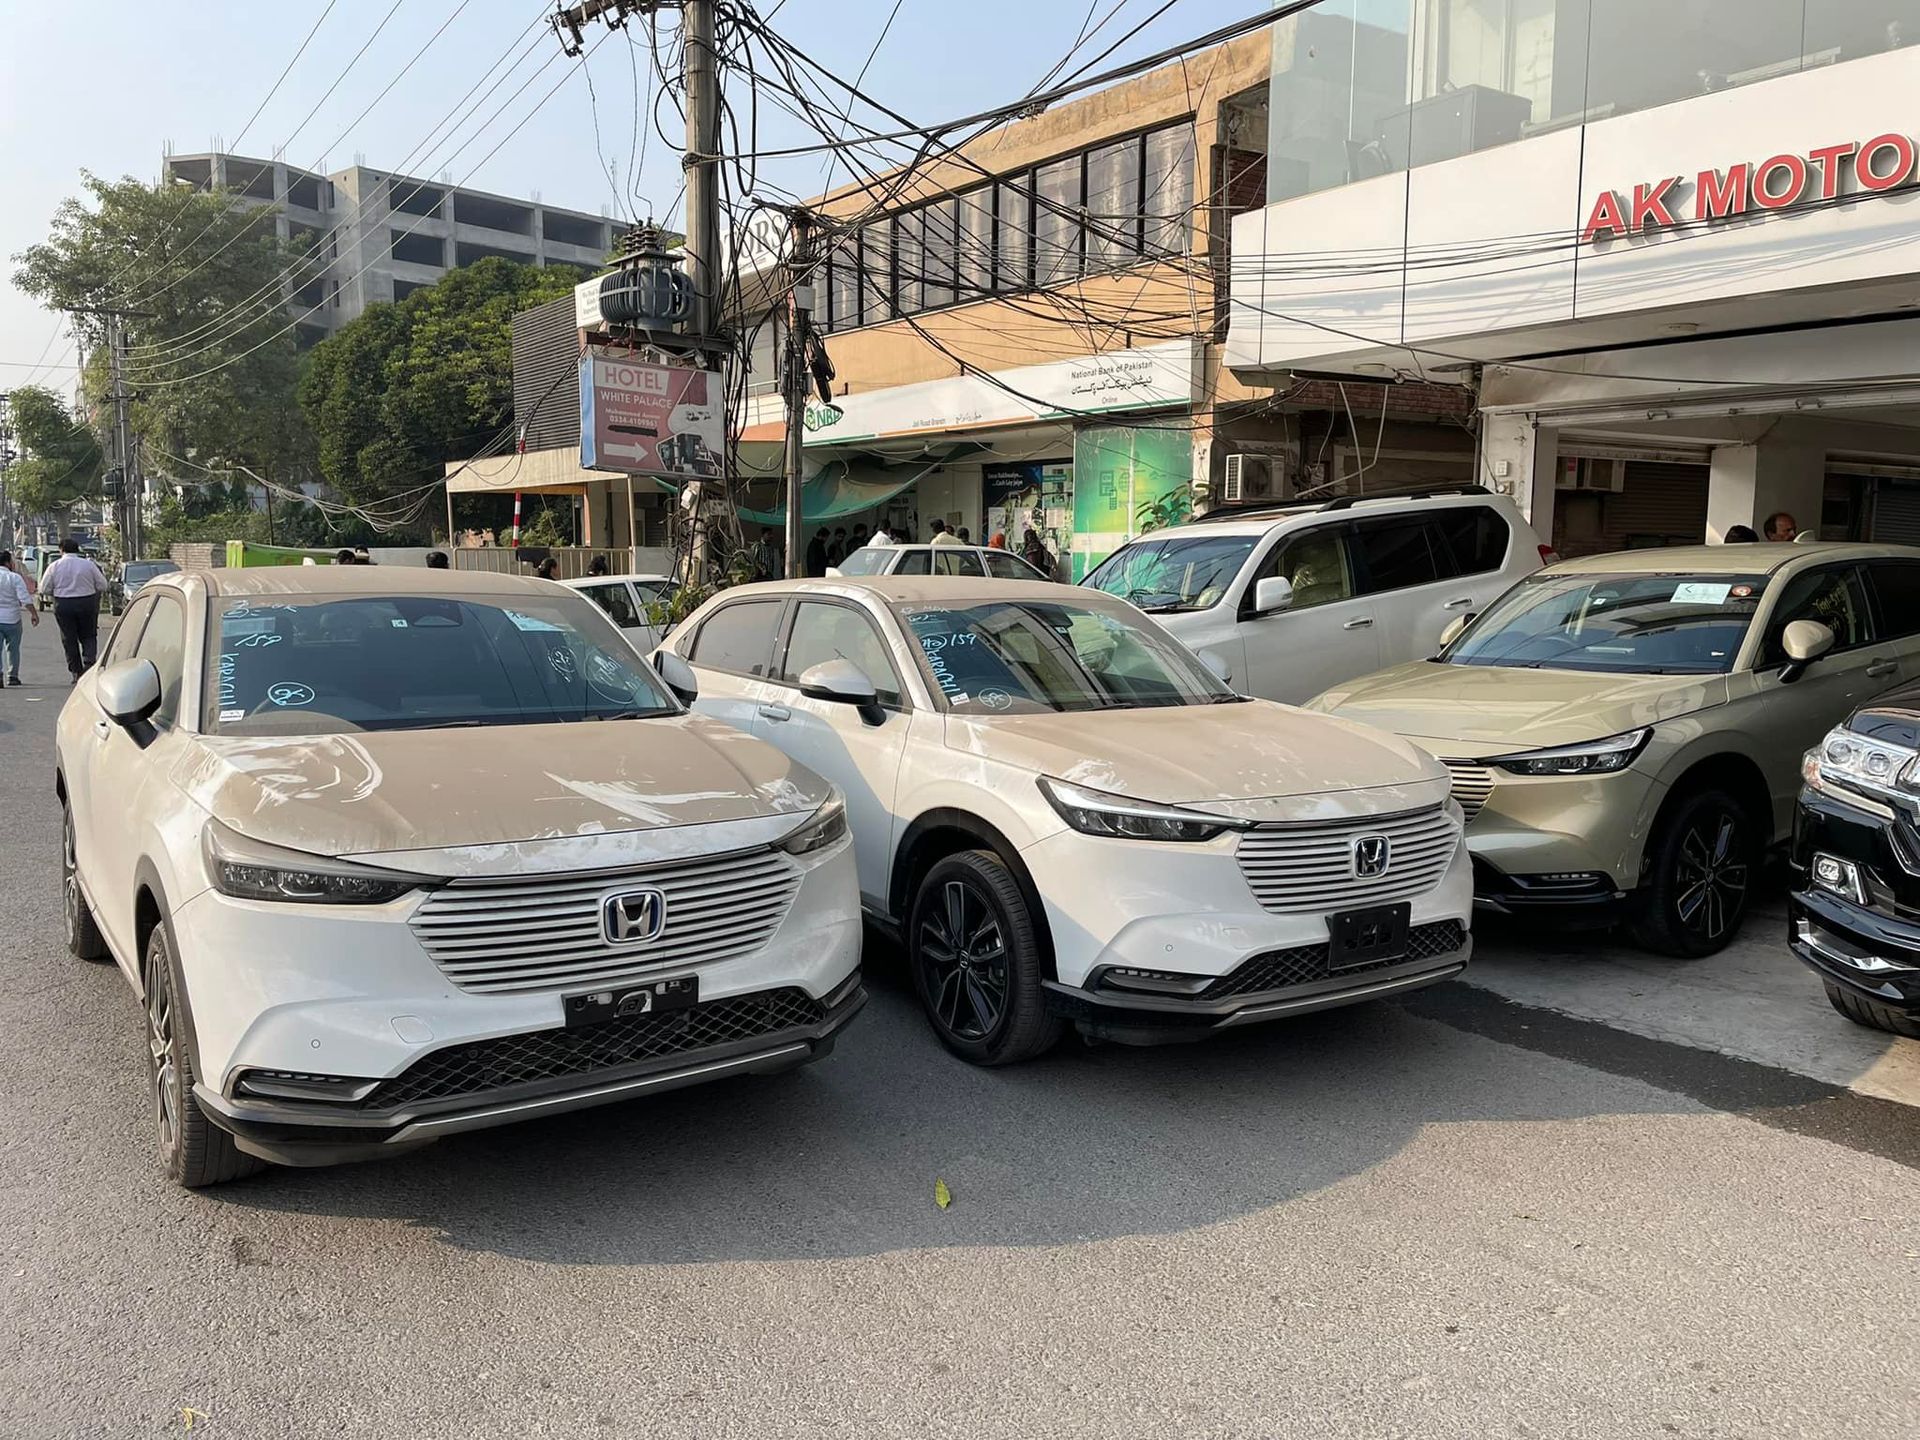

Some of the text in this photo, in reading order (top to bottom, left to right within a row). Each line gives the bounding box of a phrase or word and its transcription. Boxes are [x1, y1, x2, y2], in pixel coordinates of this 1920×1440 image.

[1581, 133, 1920, 241] AK MOTO
[605, 365, 662, 390] HOTEL
[1071, 360, 1153, 379] National Bank of Pakistan
[600, 390, 673, 409] WHITE PALACE
[816, 408, 840, 427] NBP
[950, 633, 977, 647] 159
[926, 649, 961, 693] KARACHI
